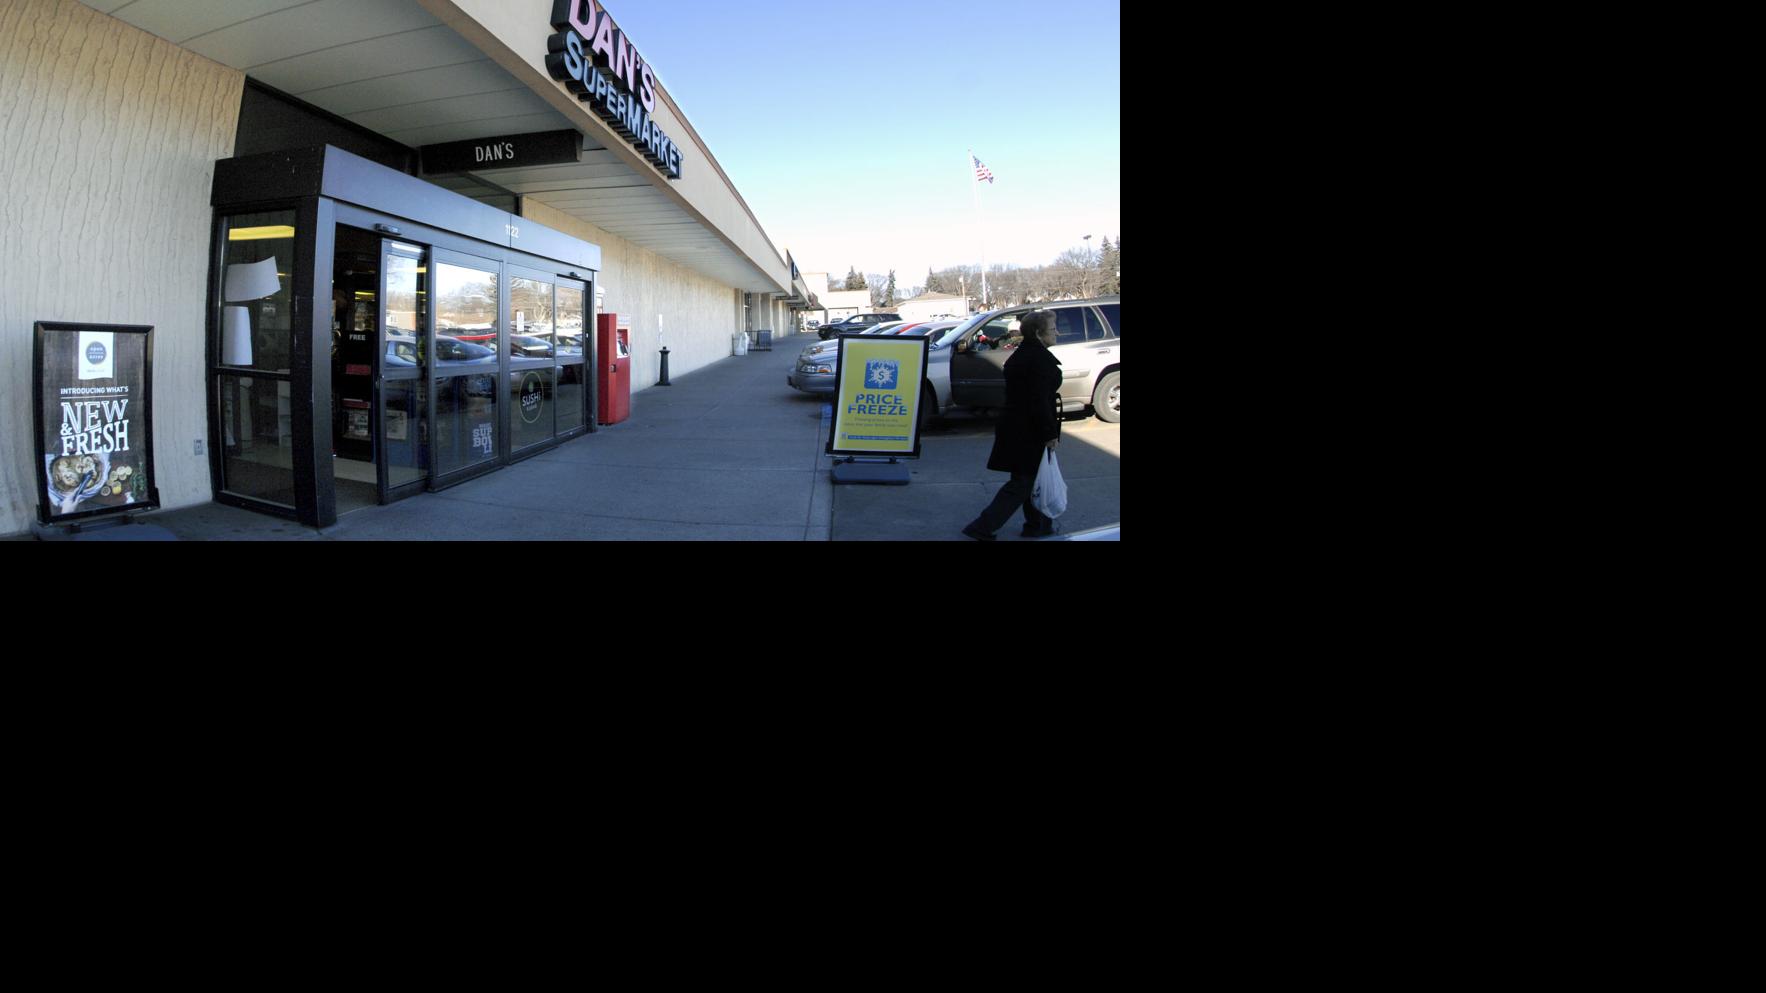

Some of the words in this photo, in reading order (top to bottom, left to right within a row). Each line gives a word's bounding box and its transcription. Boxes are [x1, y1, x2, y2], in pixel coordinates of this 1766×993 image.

[567, 0, 656, 113] DAN'S
[475, 141, 515, 163] DAN'S
[505, 224, 519, 238] 1122
[60, 387, 105, 395] INTRODUCING
[106, 385, 129, 393] WHAT'S
[855, 393, 903, 405] PRICE
[60, 399, 129, 433] NEW
[847, 404, 908, 416] FREEZE
[60, 422, 72, 436] &
[61, 419, 130, 456] FRESH
